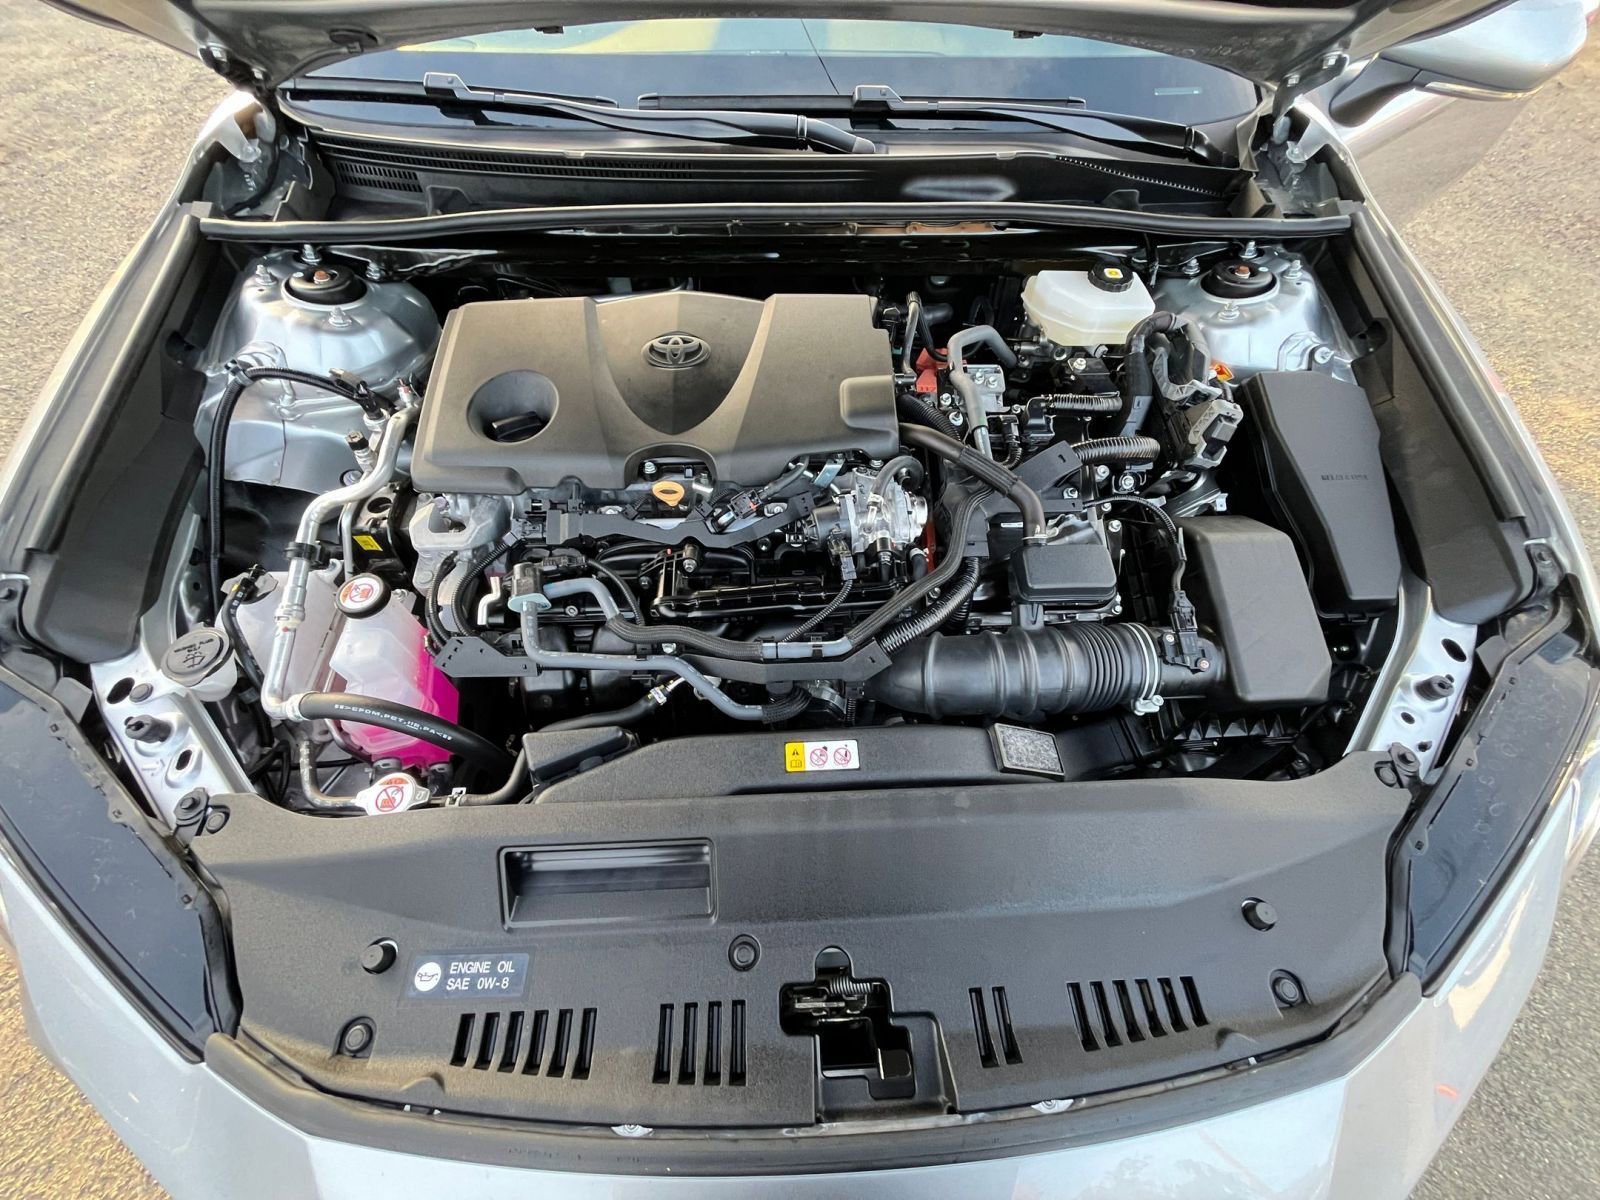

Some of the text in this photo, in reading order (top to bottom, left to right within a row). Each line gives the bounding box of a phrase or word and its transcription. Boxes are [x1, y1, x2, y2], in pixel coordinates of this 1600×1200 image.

[449, 960, 515, 974] ENGINE OIL
[446, 976, 510, 991] SAE 0W-8
